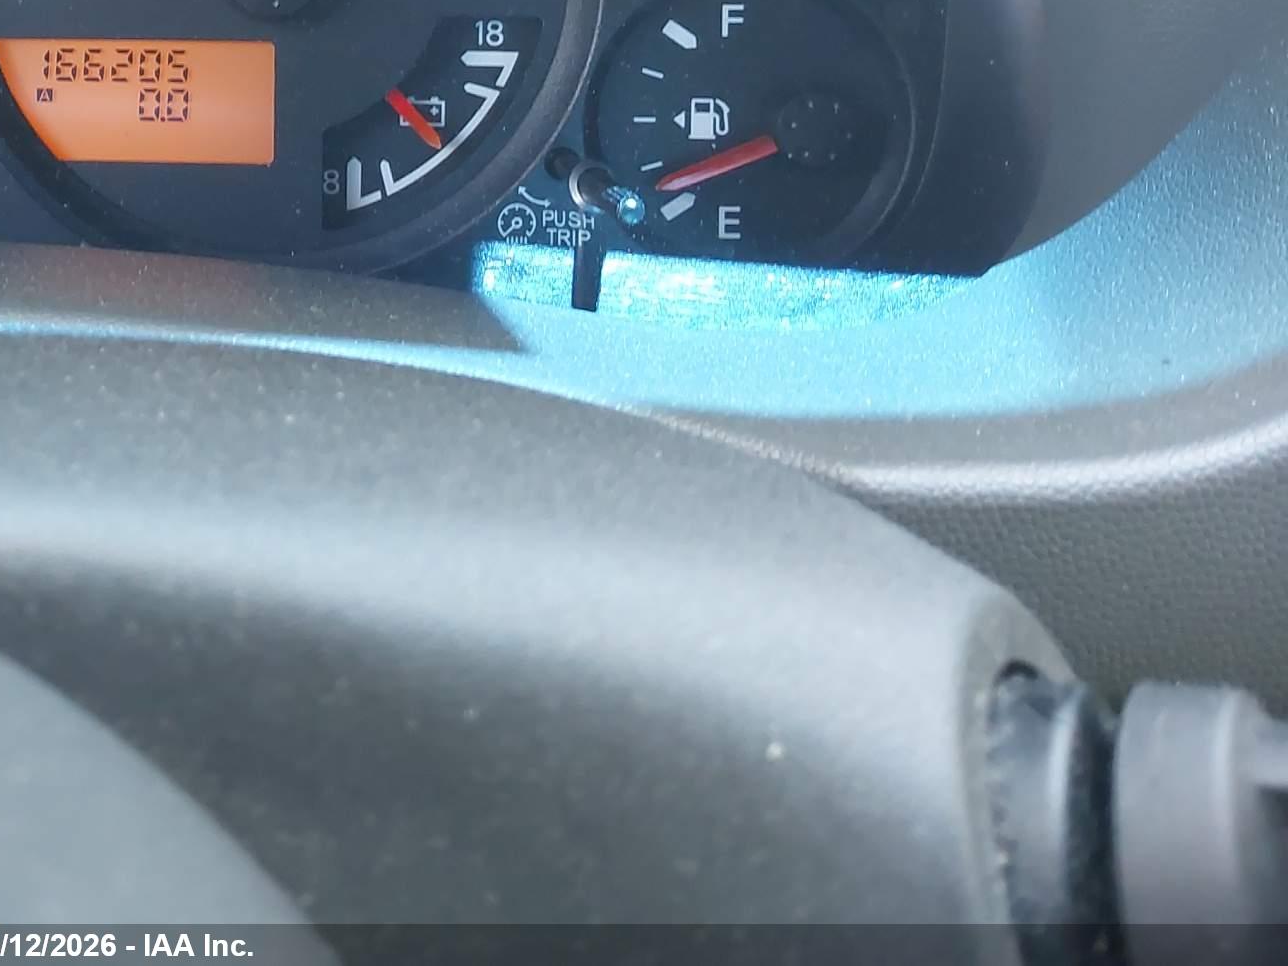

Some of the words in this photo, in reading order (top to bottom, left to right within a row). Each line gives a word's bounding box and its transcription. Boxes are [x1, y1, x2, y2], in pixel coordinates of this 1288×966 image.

[475, 20, 504, 46] 18
[722, 4, 745, 37] F
[43, 48, 189, 83] 166205
[138, 88, 189, 122] 0.0
[323, 169, 340, 195] 8
[542, 209, 595, 229] PUSH
[718, 206, 742, 240] E
[546, 228, 592, 247] TRIP
